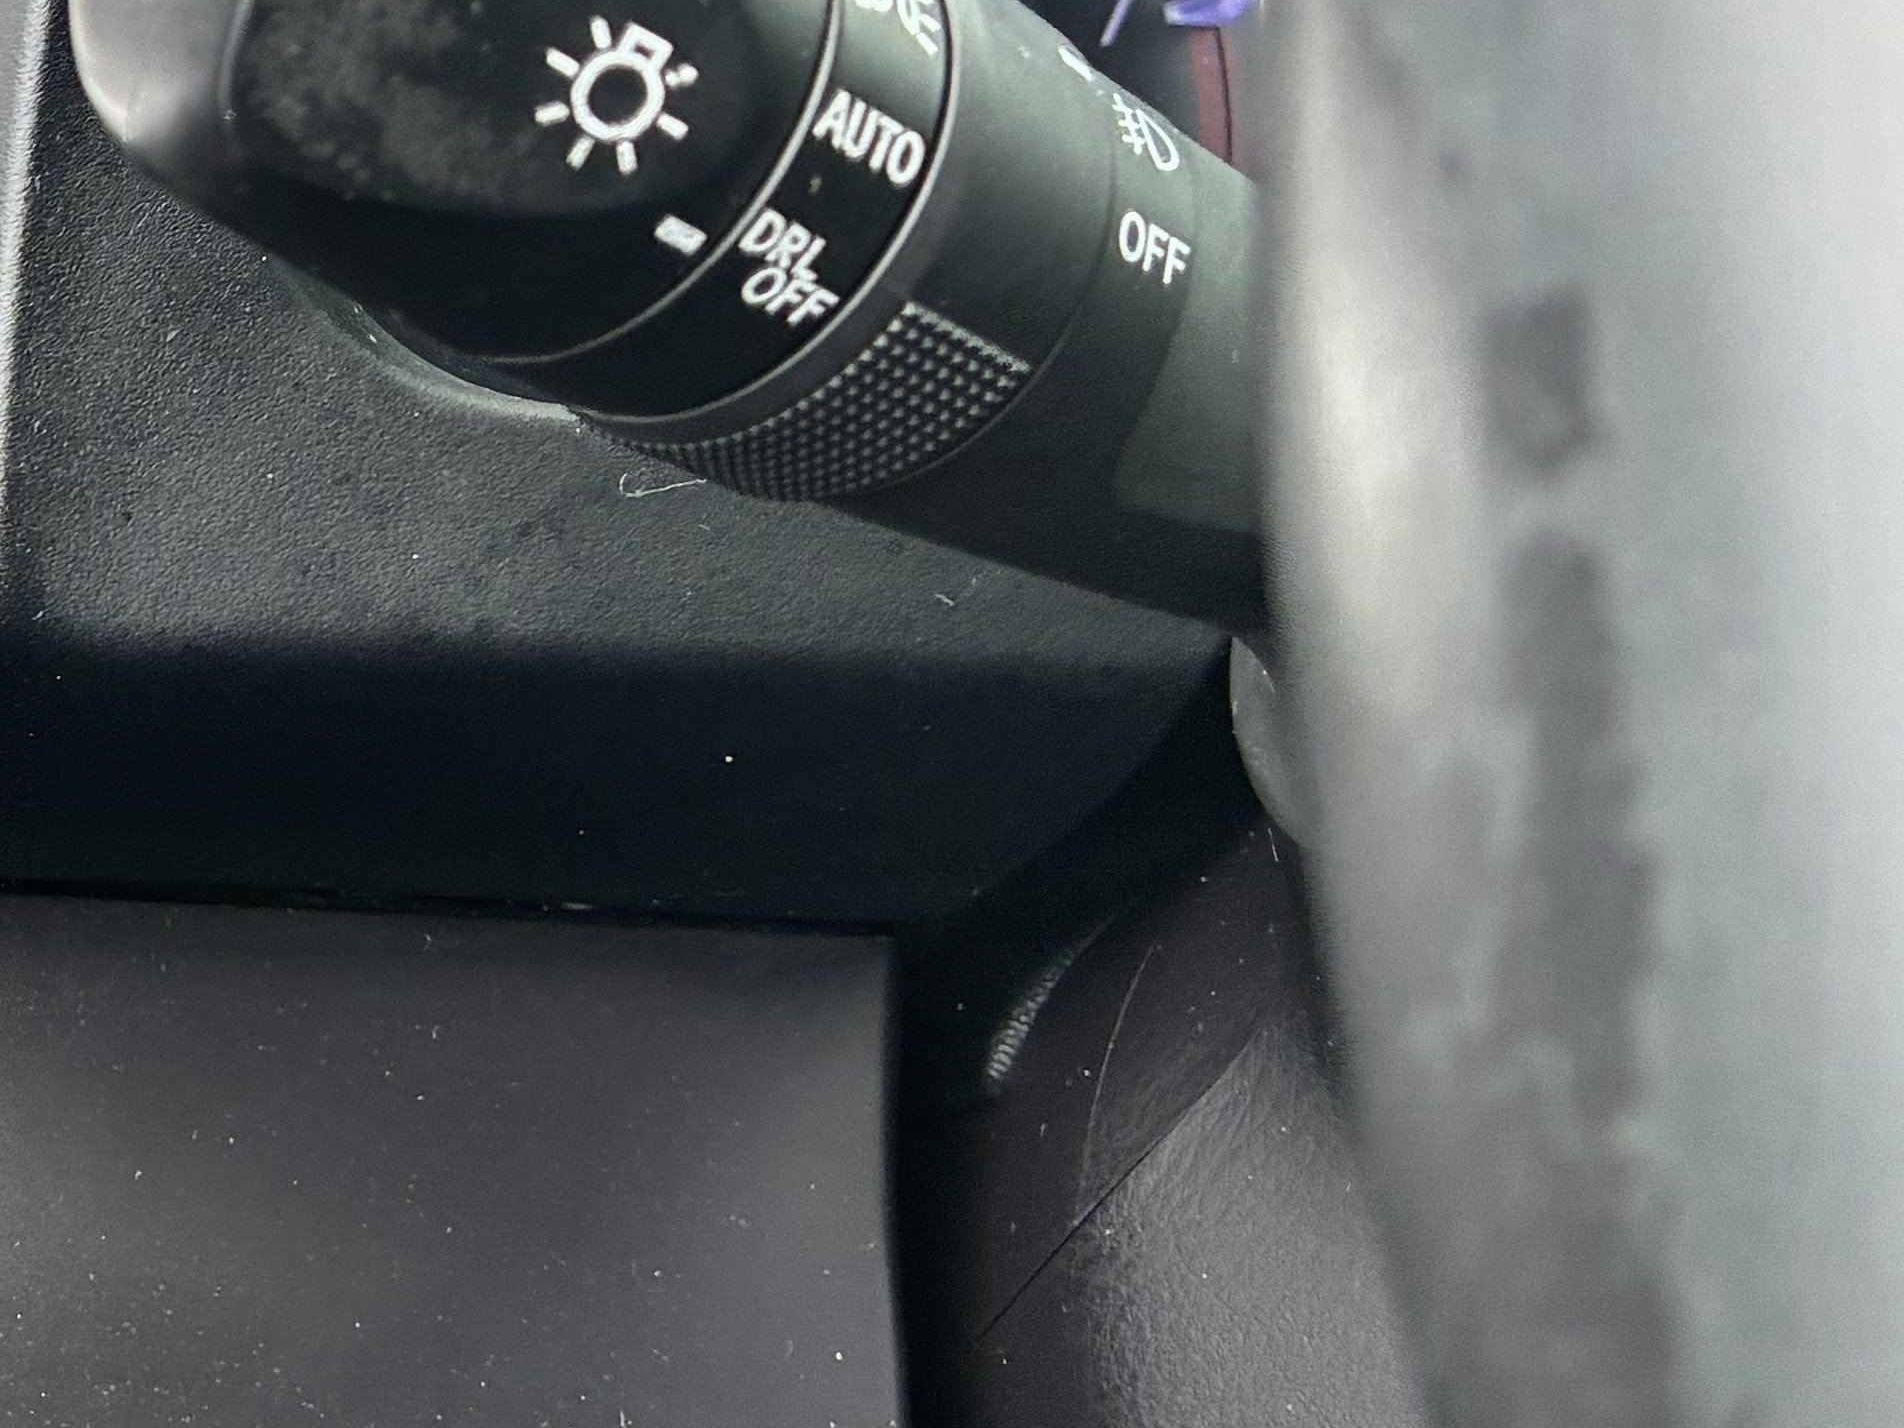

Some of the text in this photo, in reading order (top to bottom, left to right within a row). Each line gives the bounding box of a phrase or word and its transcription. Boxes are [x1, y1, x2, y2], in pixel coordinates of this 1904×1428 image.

[812, 88, 926, 188] AUTO
[738, 208, 826, 282] DRL
[1118, 211, 1192, 285] OFF
[741, 268, 840, 325] OFF
